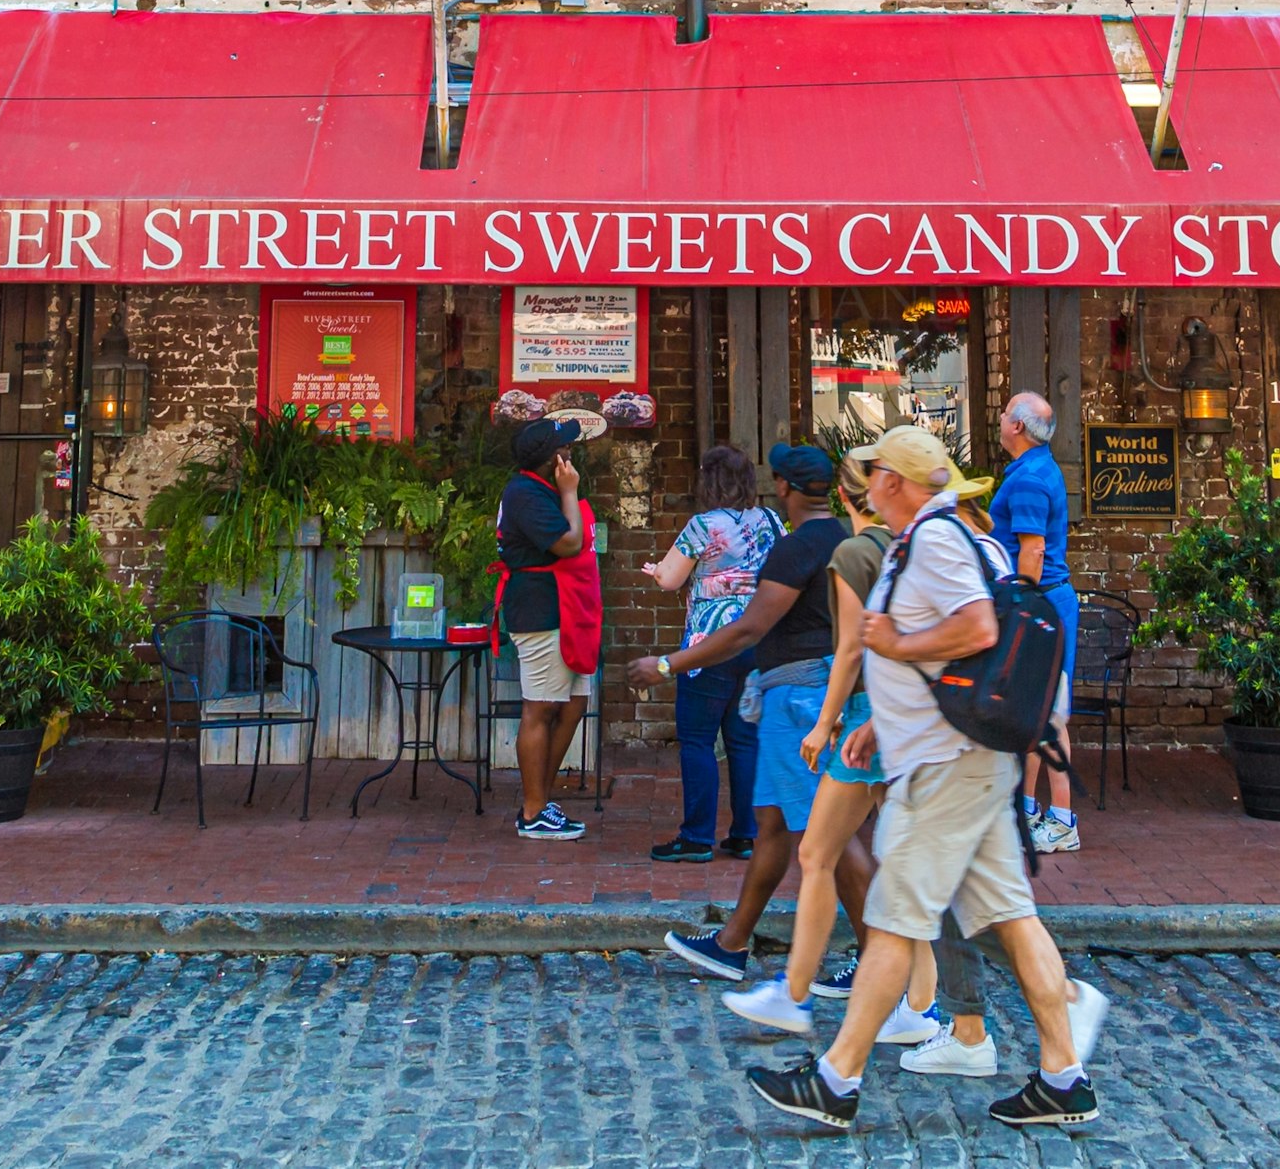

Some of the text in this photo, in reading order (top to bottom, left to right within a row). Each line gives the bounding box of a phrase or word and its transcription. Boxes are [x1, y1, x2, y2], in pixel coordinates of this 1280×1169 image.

[142, 208, 456, 270] STREET
[484, 209, 812, 275] SWEETS
[838, 212, 1143, 276] CANDY
[523, 294, 581, 306] Manager's
[531, 304, 578, 314] Specials
[304, 315, 371, 323] RIVER STREET
[317, 319, 358, 333] Sweets
[325, 341, 345, 349] BEST
[526, 346, 587, 356] Only $5.95
[555, 363, 599, 374] SHIPPING
[364, 374, 375, 382] Shop
[1105, 436, 1157, 450] World
[1095, 450, 1169, 464] Famous
[56, 479, 70, 487] PUSH
[1092, 467, 1174, 501] Pralines
